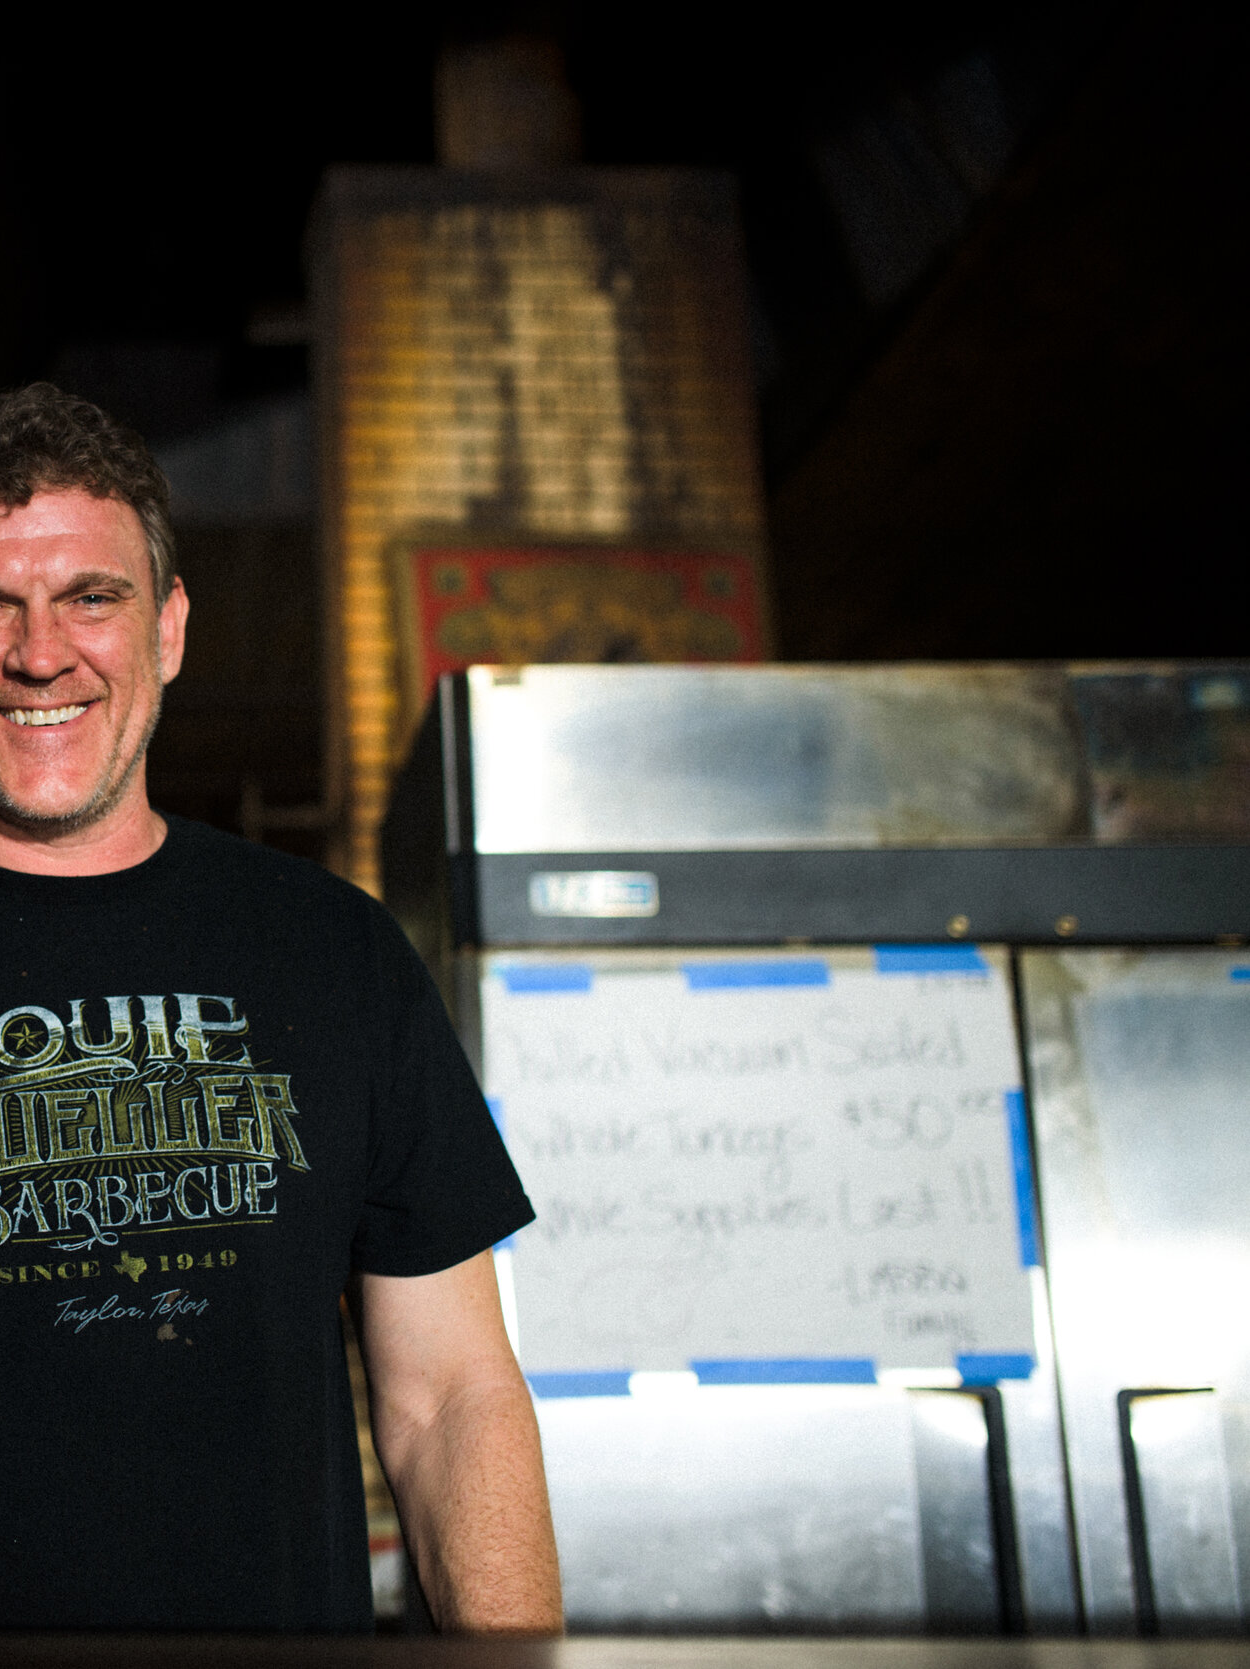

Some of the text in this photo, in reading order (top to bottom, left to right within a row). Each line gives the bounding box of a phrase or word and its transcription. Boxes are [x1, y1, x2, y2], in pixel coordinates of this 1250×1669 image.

[158, 1248, 239, 1273] 1949
[54, 1288, 211, 1334] Taylor, Texas
